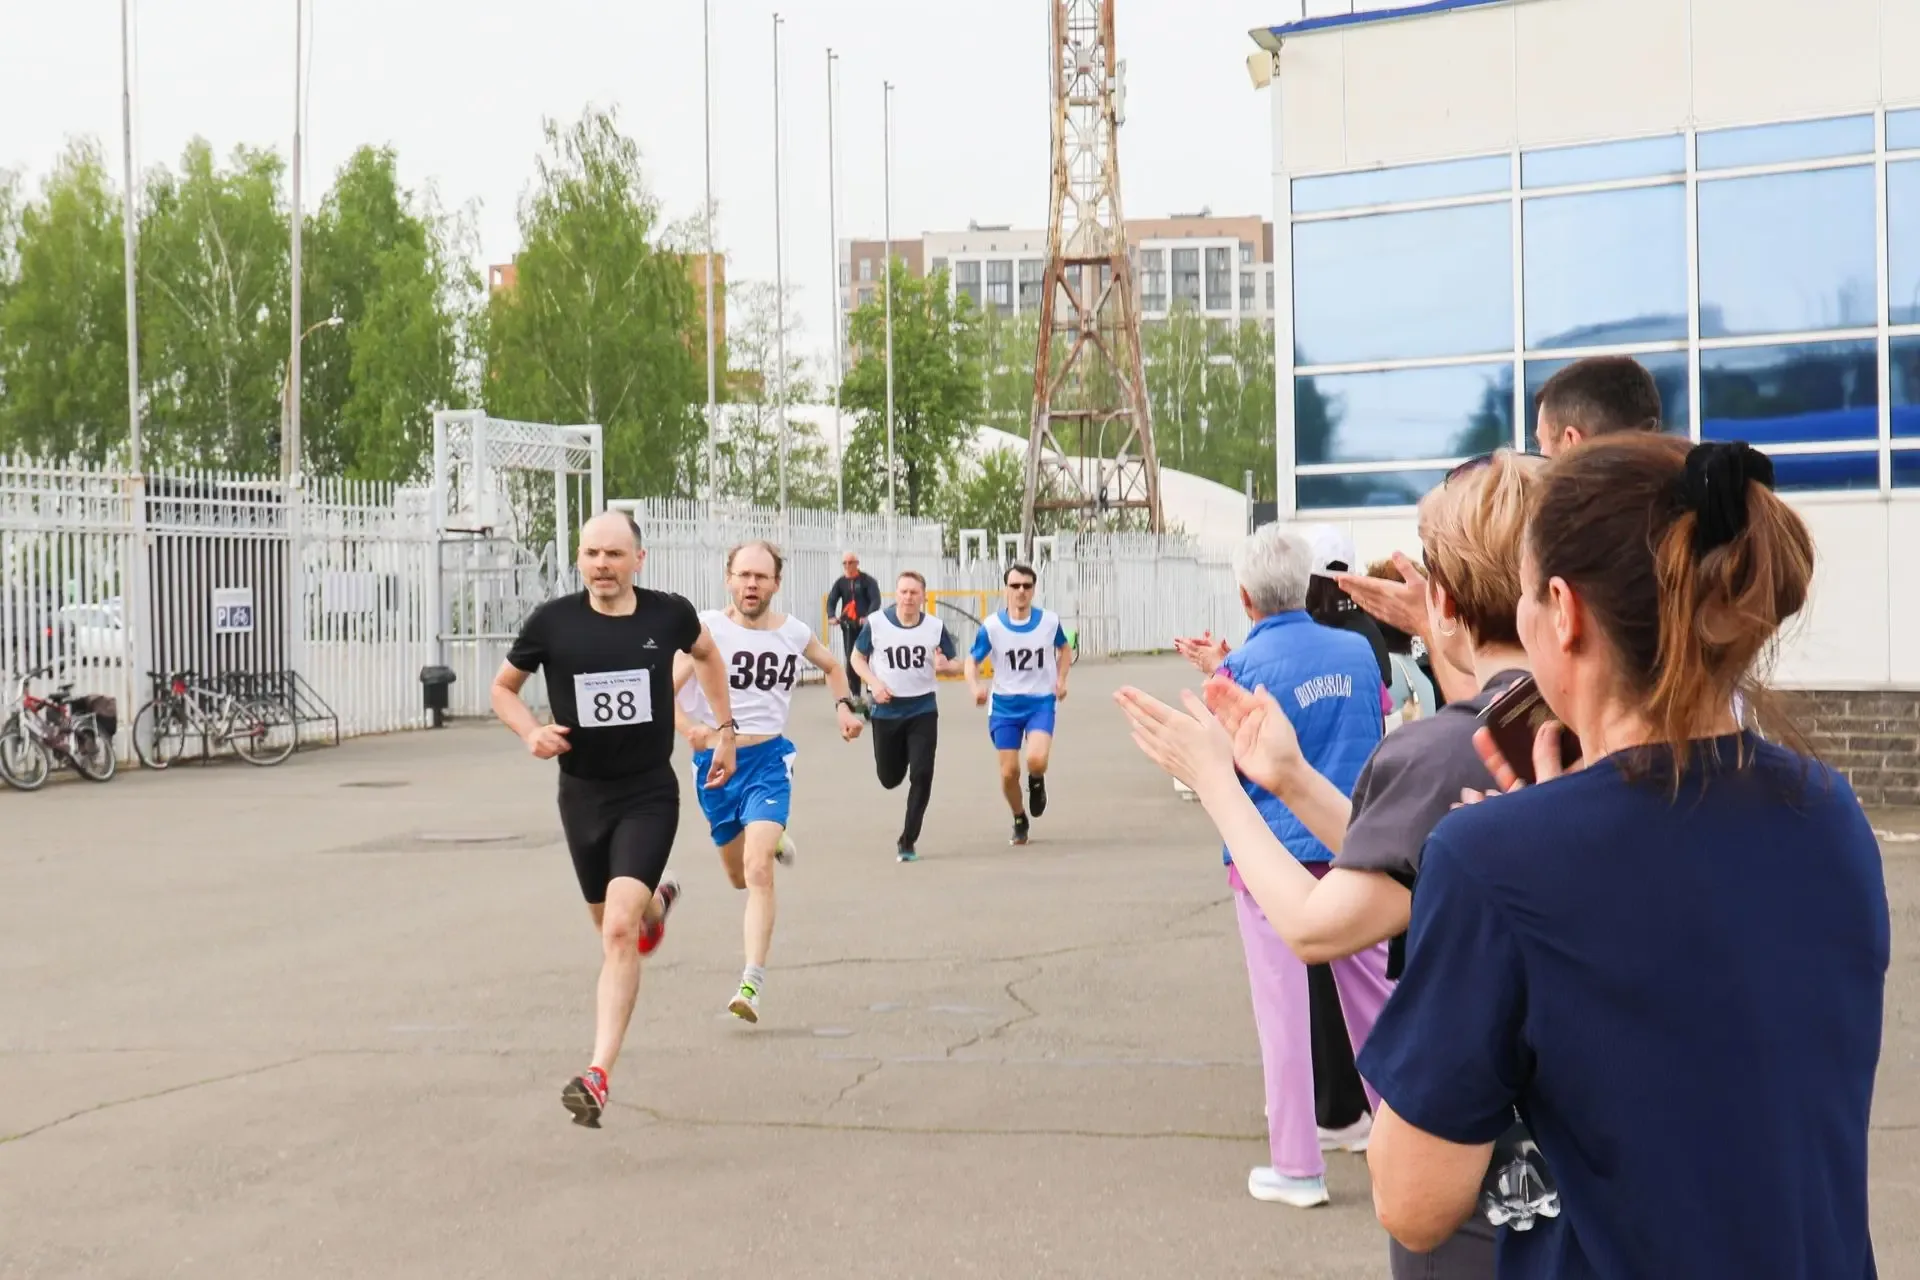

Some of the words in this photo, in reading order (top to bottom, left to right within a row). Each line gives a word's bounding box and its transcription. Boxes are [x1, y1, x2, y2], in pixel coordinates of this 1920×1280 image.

[217, 606, 227, 627] P
[730, 651, 797, 691] 364
[884, 645, 927, 670] 103
[1005, 648, 1045, 671] 121
[1294, 673, 1352, 709] RUSSIA
[593, 691, 637, 722] 88
